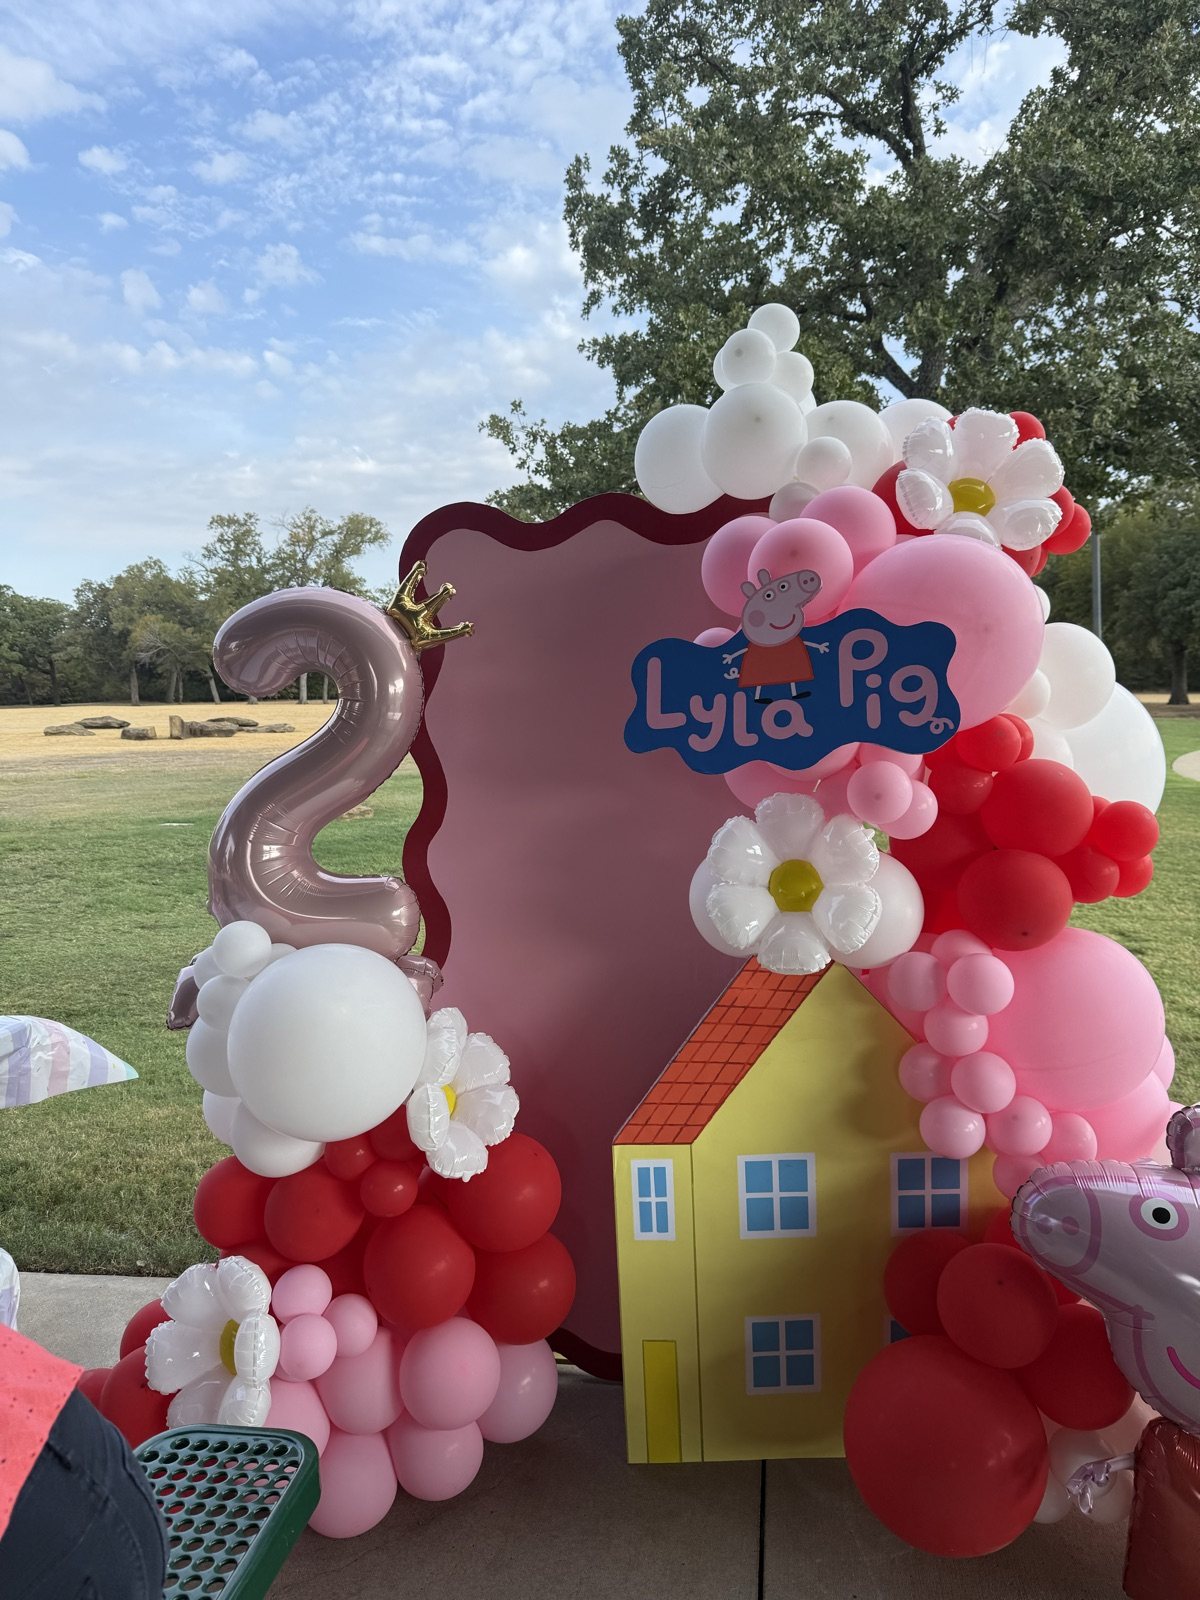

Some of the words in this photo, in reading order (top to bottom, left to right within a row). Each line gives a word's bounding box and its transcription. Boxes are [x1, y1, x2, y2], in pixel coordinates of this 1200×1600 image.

[209, 586, 425, 960] 2
[646, 656, 814, 752] Lyla
[838, 628, 940, 729] Pig
